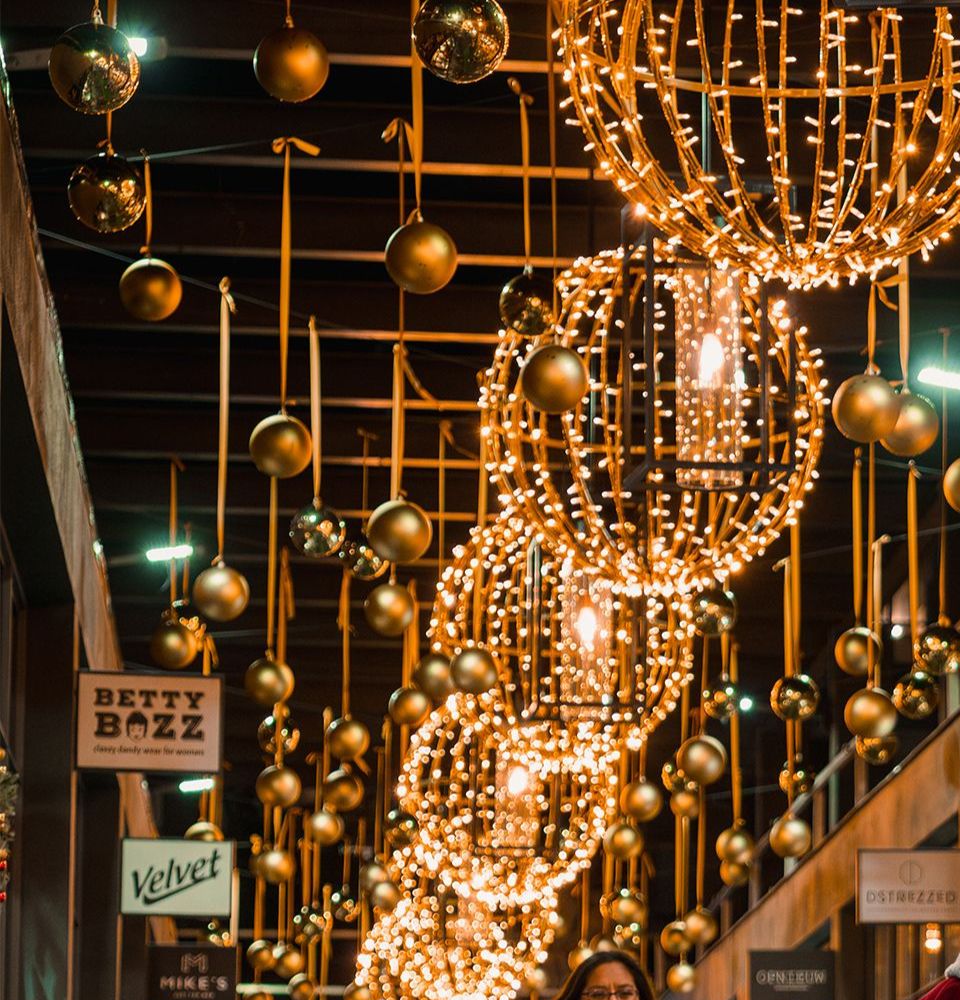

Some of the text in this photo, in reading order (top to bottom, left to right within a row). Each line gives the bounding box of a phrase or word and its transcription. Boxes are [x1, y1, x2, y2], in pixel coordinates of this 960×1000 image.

[94, 688, 204, 709] BETTY
[163, 746, 175, 755] for
[131, 848, 221, 899] Velvet
